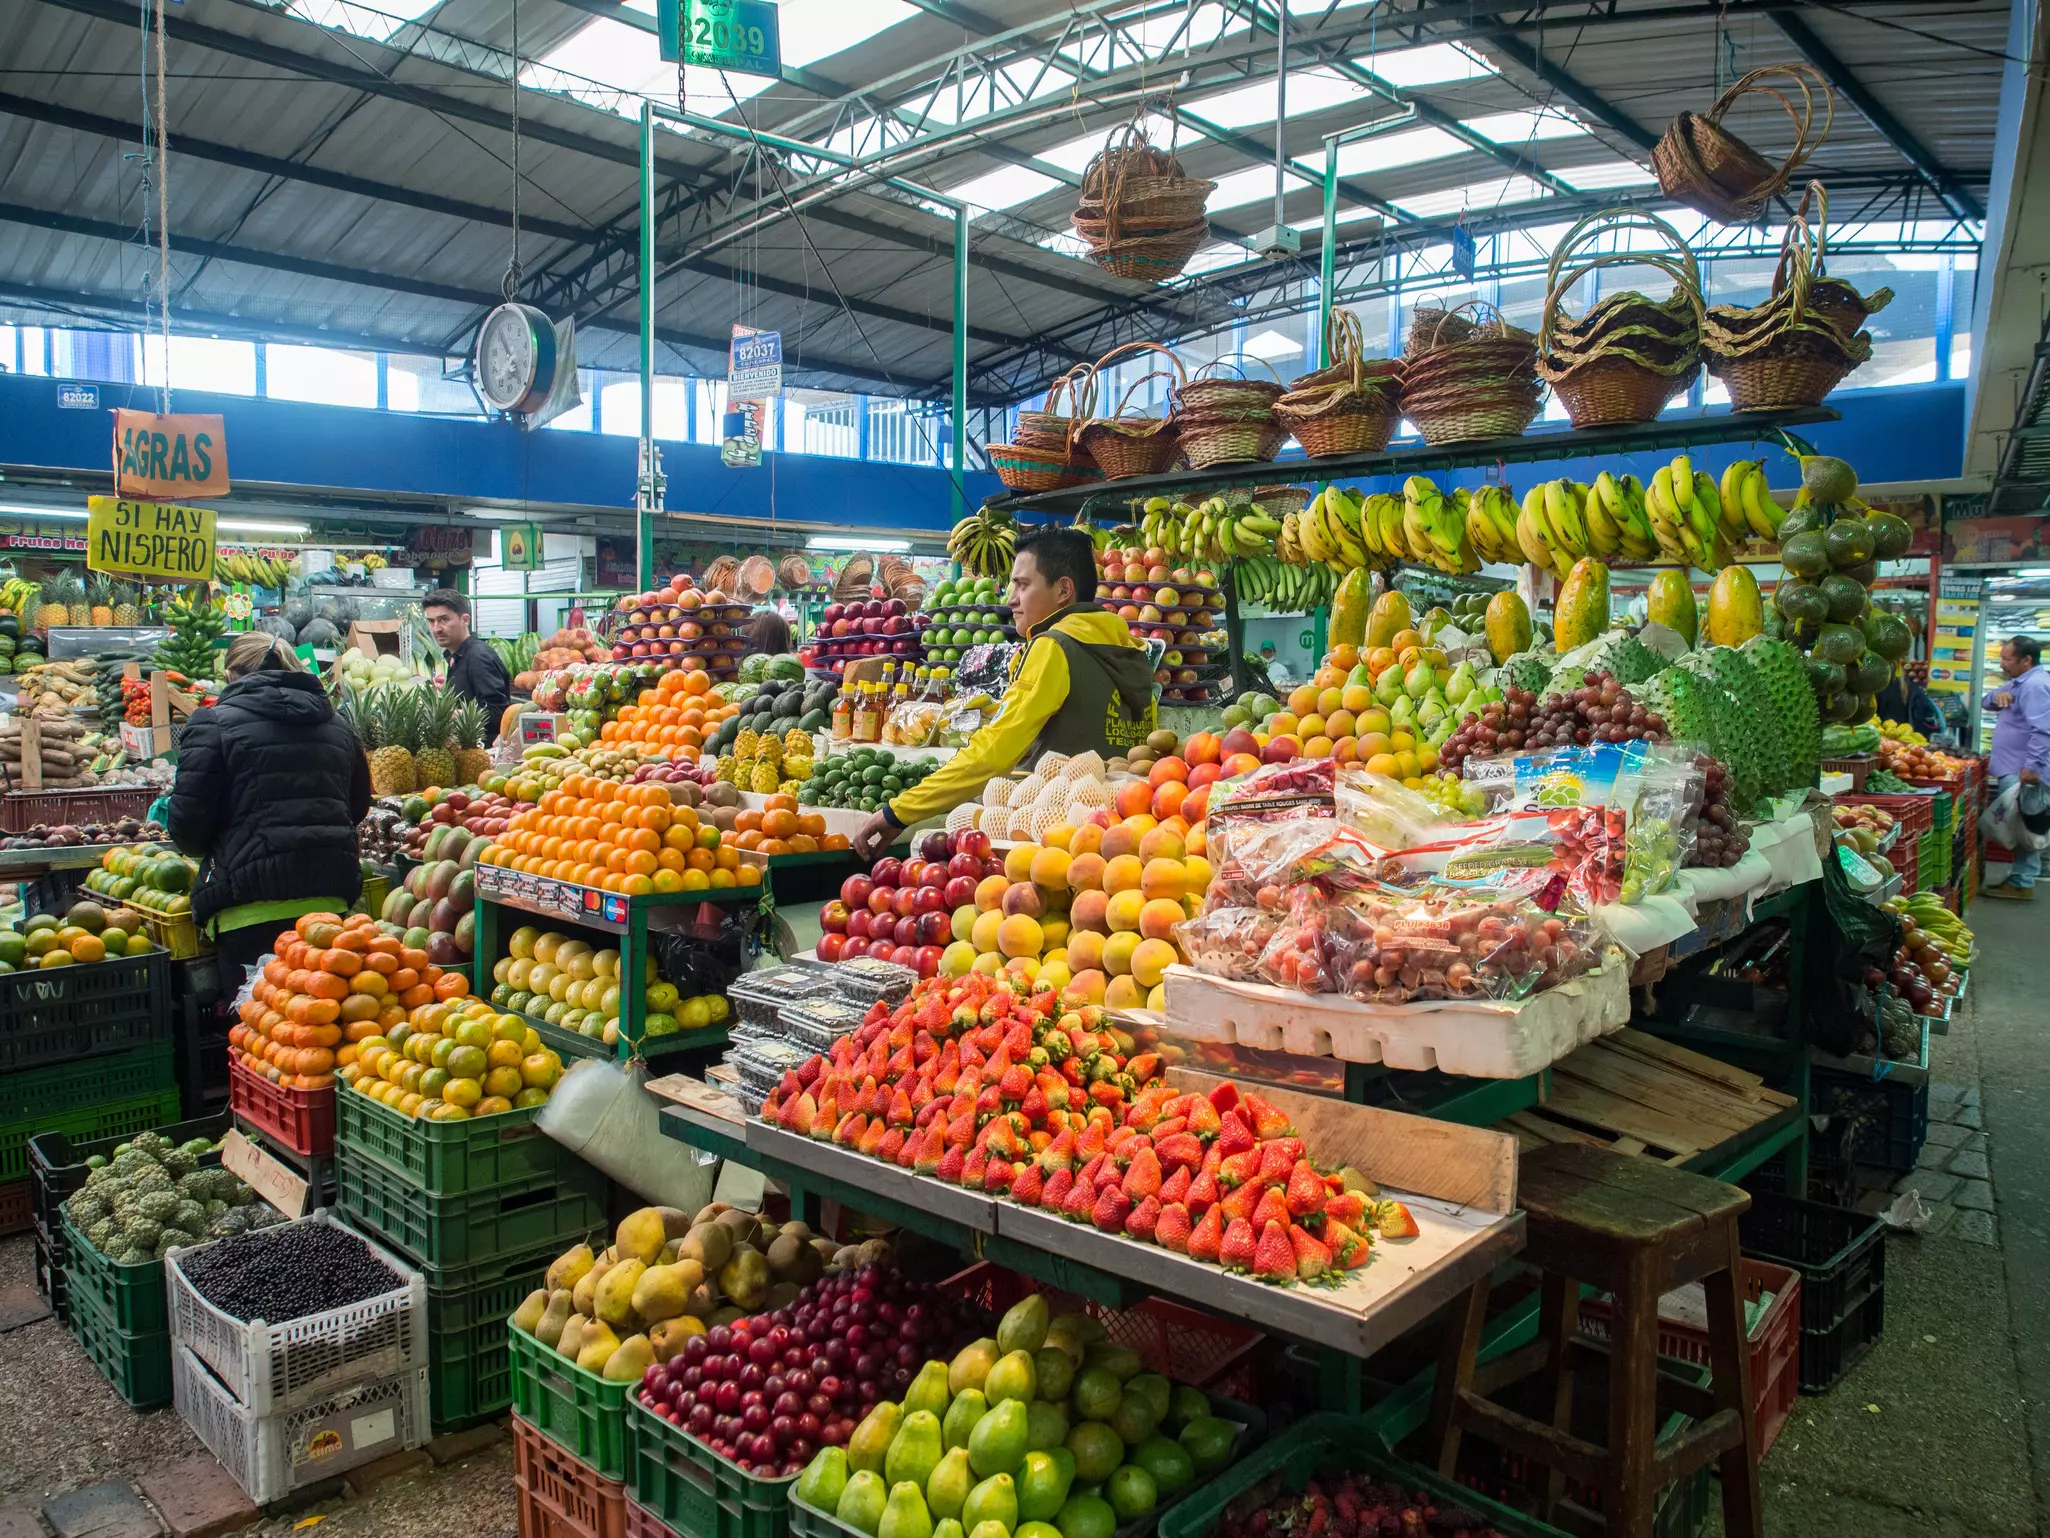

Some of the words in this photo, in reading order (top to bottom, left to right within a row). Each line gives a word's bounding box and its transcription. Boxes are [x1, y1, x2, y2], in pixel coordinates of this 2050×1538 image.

[740, 342, 775, 360] 82037
[733, 368, 777, 381] BIENVENIDO
[63, 392, 94, 403] 82022
[122, 428, 213, 481] AGRAS
[116, 501, 140, 528] SI
[156, 509, 203, 534] HAY
[10, 536, 61, 549] Frutas
[101, 529, 207, 573] NISPERO
[1453, 861, 1488, 871] SEEDED
[1393, 919, 1416, 930] PLU
